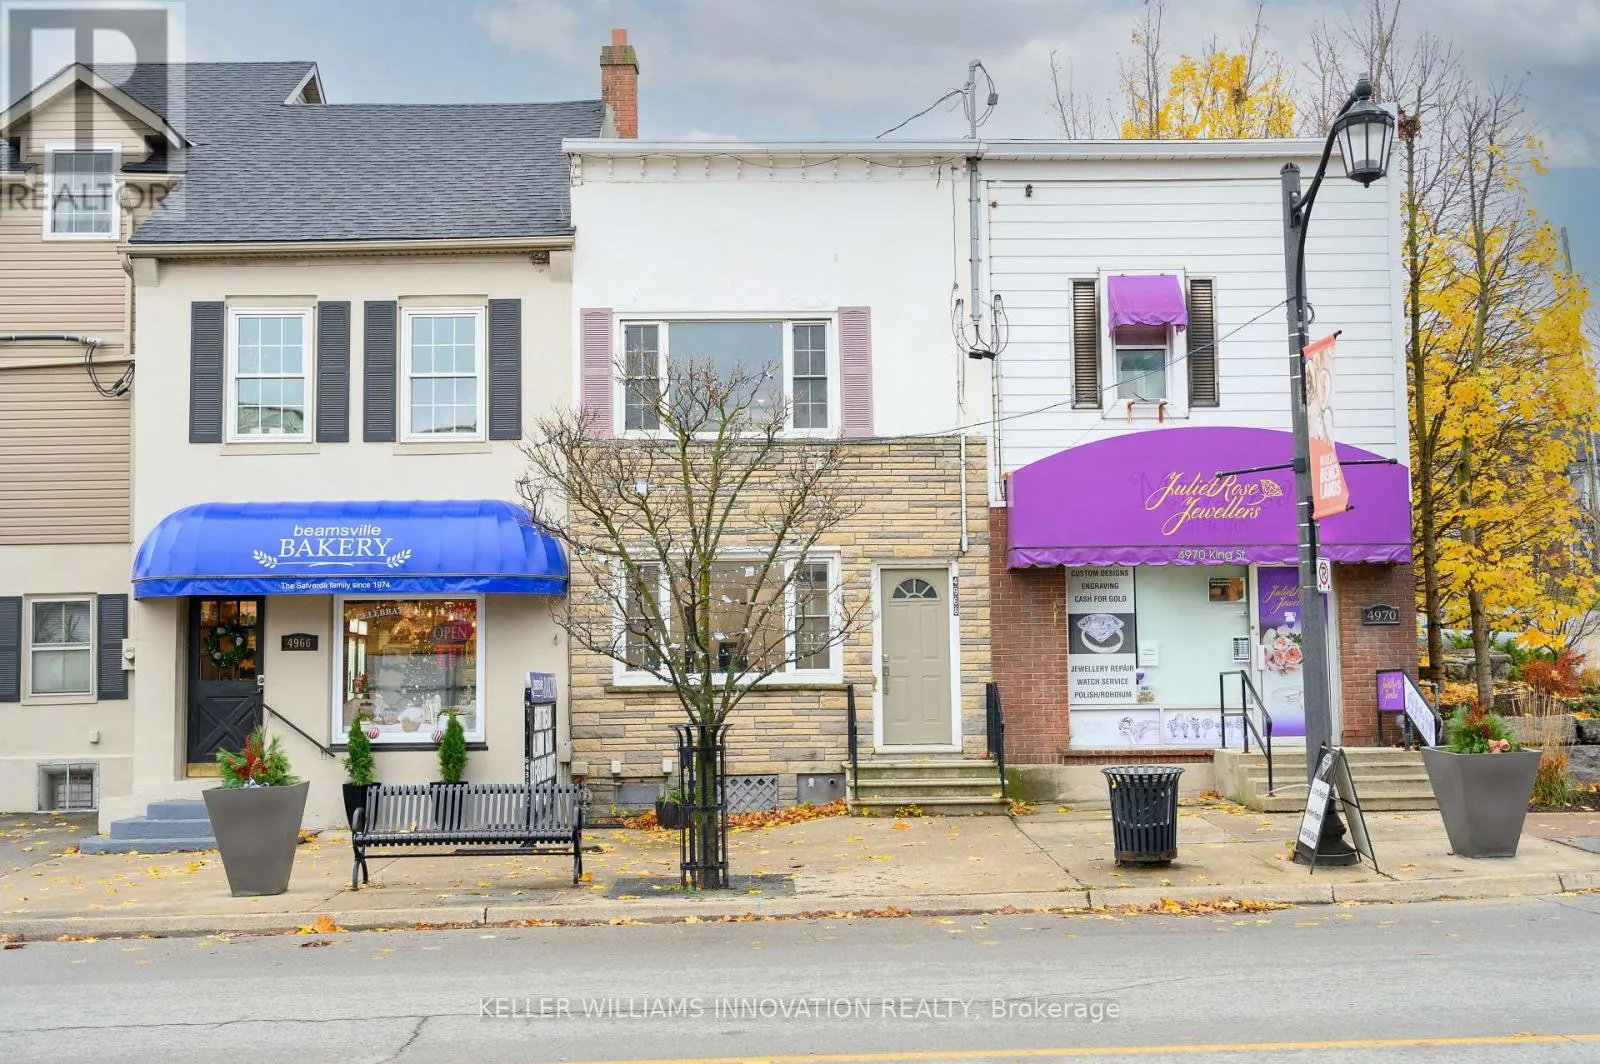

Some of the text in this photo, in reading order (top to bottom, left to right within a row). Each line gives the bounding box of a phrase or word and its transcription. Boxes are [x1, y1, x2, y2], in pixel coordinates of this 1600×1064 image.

[1162, 496, 1261, 536] Jewellers
[293, 524, 382, 537] beamsville
[277, 537, 394, 558] BAKERY
[1178, 549, 1206, 560] 4970
[1209, 549, 1233, 562] King
[1071, 569, 1129, 577] CUSTOM DESIGNS
[281, 582, 294, 590] The
[329, 581, 351, 591] family
[373, 581, 390, 589] 1974
[1081, 582, 1119, 590] ENGRAVING
[1074, 595, 1127, 603] CASH FOR GOLD
[1367, 609, 1397, 621] 4970
[433, 625, 467, 641] OPEN
[287, 638, 312, 648] 4966
[1070, 664, 1134, 673] JEWELLERY REPAIR
[1076, 677, 1129, 686] WATCH SERVICE
